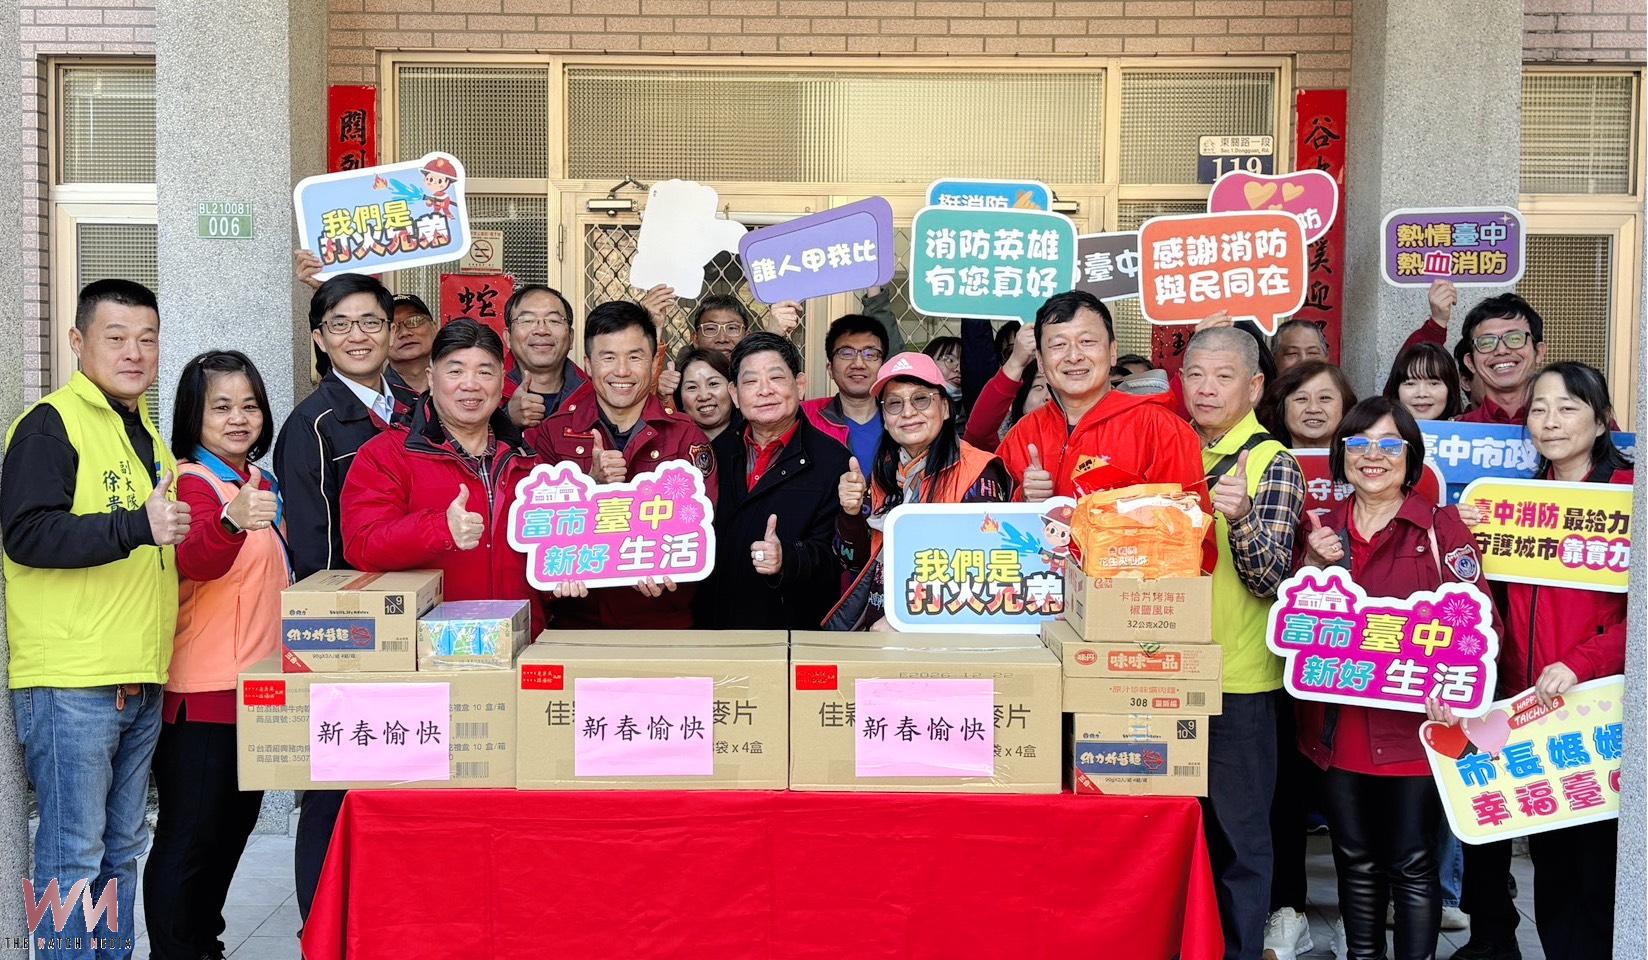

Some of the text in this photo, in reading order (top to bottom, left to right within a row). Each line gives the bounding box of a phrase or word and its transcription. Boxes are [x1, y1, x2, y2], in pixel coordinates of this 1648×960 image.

[1212, 157, 1263, 181] 119
[199, 203, 251, 215] BL210081
[322, 200, 413, 238] 我們是
[208, 217, 240, 236] 006
[318, 215, 451, 264] 打火兄弟
[1397, 221, 1507, 248] 熱情臺中
[926, 229, 1060, 261] 消防英雄
[1152, 228, 1288, 270] 感謝消防
[751, 239, 878, 283] 誰人甲我比
[1074, 249, 1138, 283] 臺中
[1397, 250, 1507, 276] 熱血消防
[926, 265, 1058, 298] 有您真好
[1154, 264, 1291, 306] 與民同在
[458, 284, 498, 317] 蛇
[914, 548, 1022, 584] 我們是
[396, 597, 403, 606] 9
[906, 571, 1065, 616] 打火兄弟
[385, 605, 396, 614] 10
[1110, 652, 1179, 670] 味味一品
[545, 700, 576, 727] 佳
[1130, 698, 1148, 708] 308
[317, 719, 443, 747] 新春愉快
[583, 714, 705, 741] 新春愉快
[862, 716, 986, 742] 新春愉快
[1178, 730, 1189, 738] 10
[1188, 720, 1195, 730] 9
[742, 741, 763, 754] 4盒
[1015, 744, 1037, 758] 4盒
